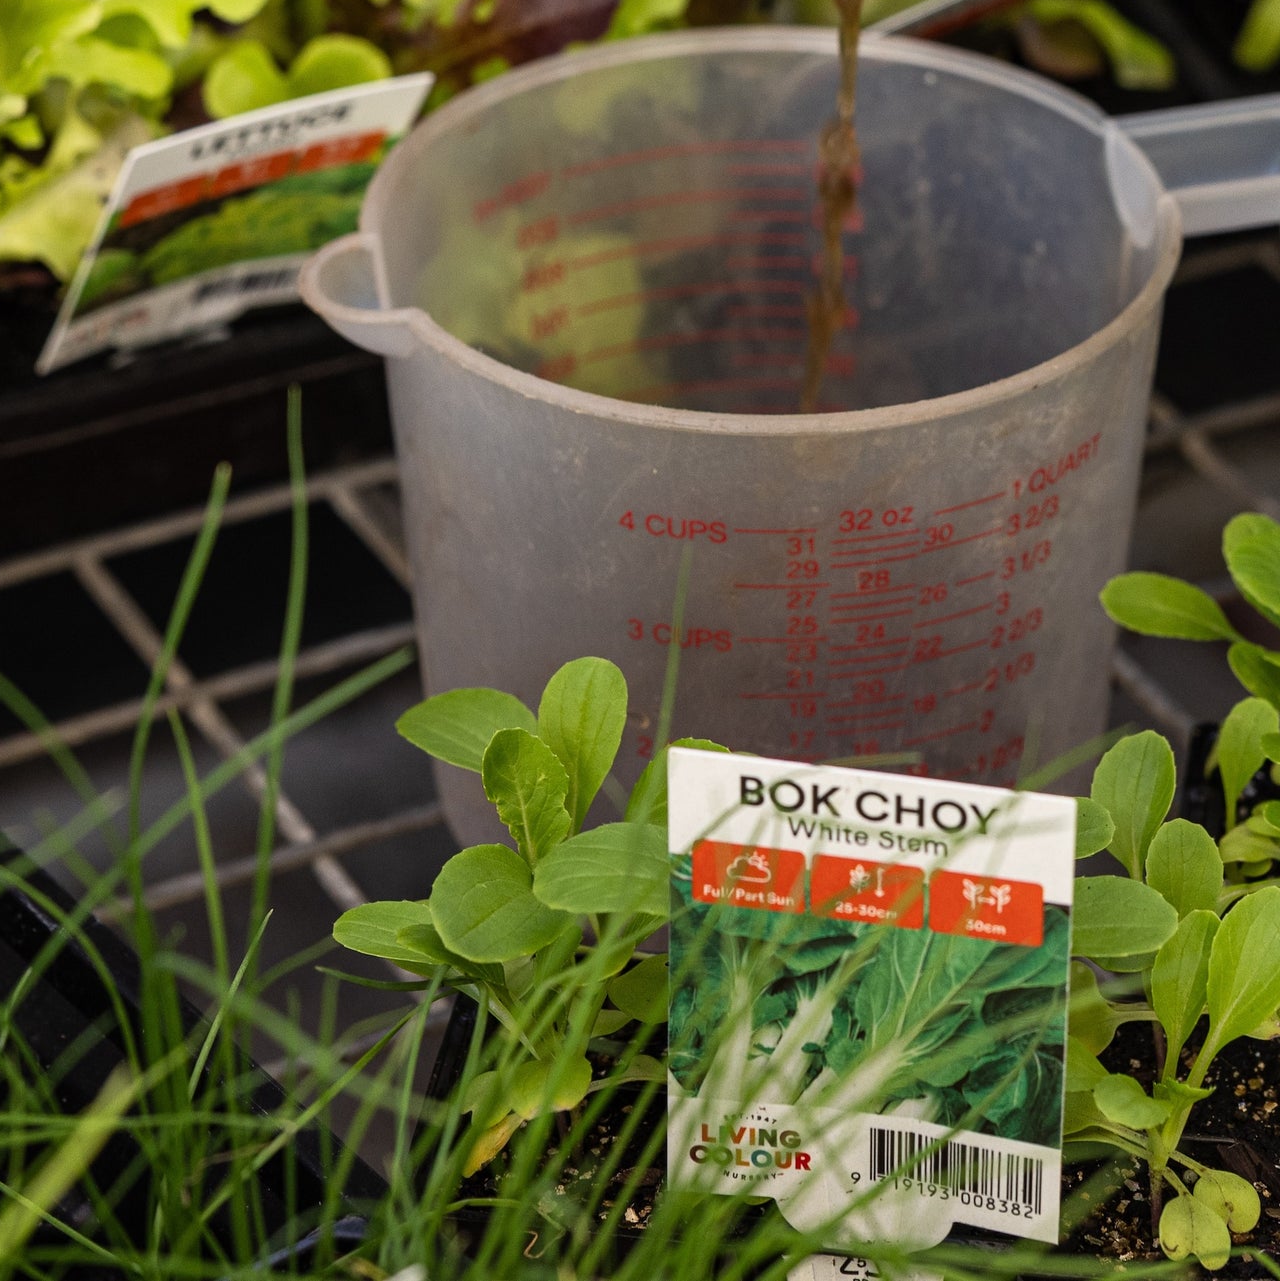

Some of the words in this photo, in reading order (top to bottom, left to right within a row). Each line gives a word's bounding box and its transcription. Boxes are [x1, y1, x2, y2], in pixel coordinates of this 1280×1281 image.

[1028, 432, 1102, 493] QUART
[620, 510, 635, 531] 4
[644, 513, 728, 544] CUPS
[839, 509, 873, 533] 32
[786, 537, 815, 555] 31
[924, 523, 954, 545] 30
[786, 560, 820, 579] 29
[859, 570, 890, 590] 28
[786, 591, 817, 610] 27
[628, 618, 644, 640] 3
[652, 623, 733, 653] CUPS
[786, 616, 819, 635] 25
[740, 775, 841, 817] BOK
[855, 790, 999, 834] CHOY
[788, 816, 869, 847] White
[879, 830, 948, 857] Stem
[767, 894, 795, 907] Sun
[701, 1123, 801, 1148] LIVING
[689, 1144, 811, 1170] COLOUR
[851, 1172, 861, 1184] 9
[961, 1191, 1033, 1219] 008382
